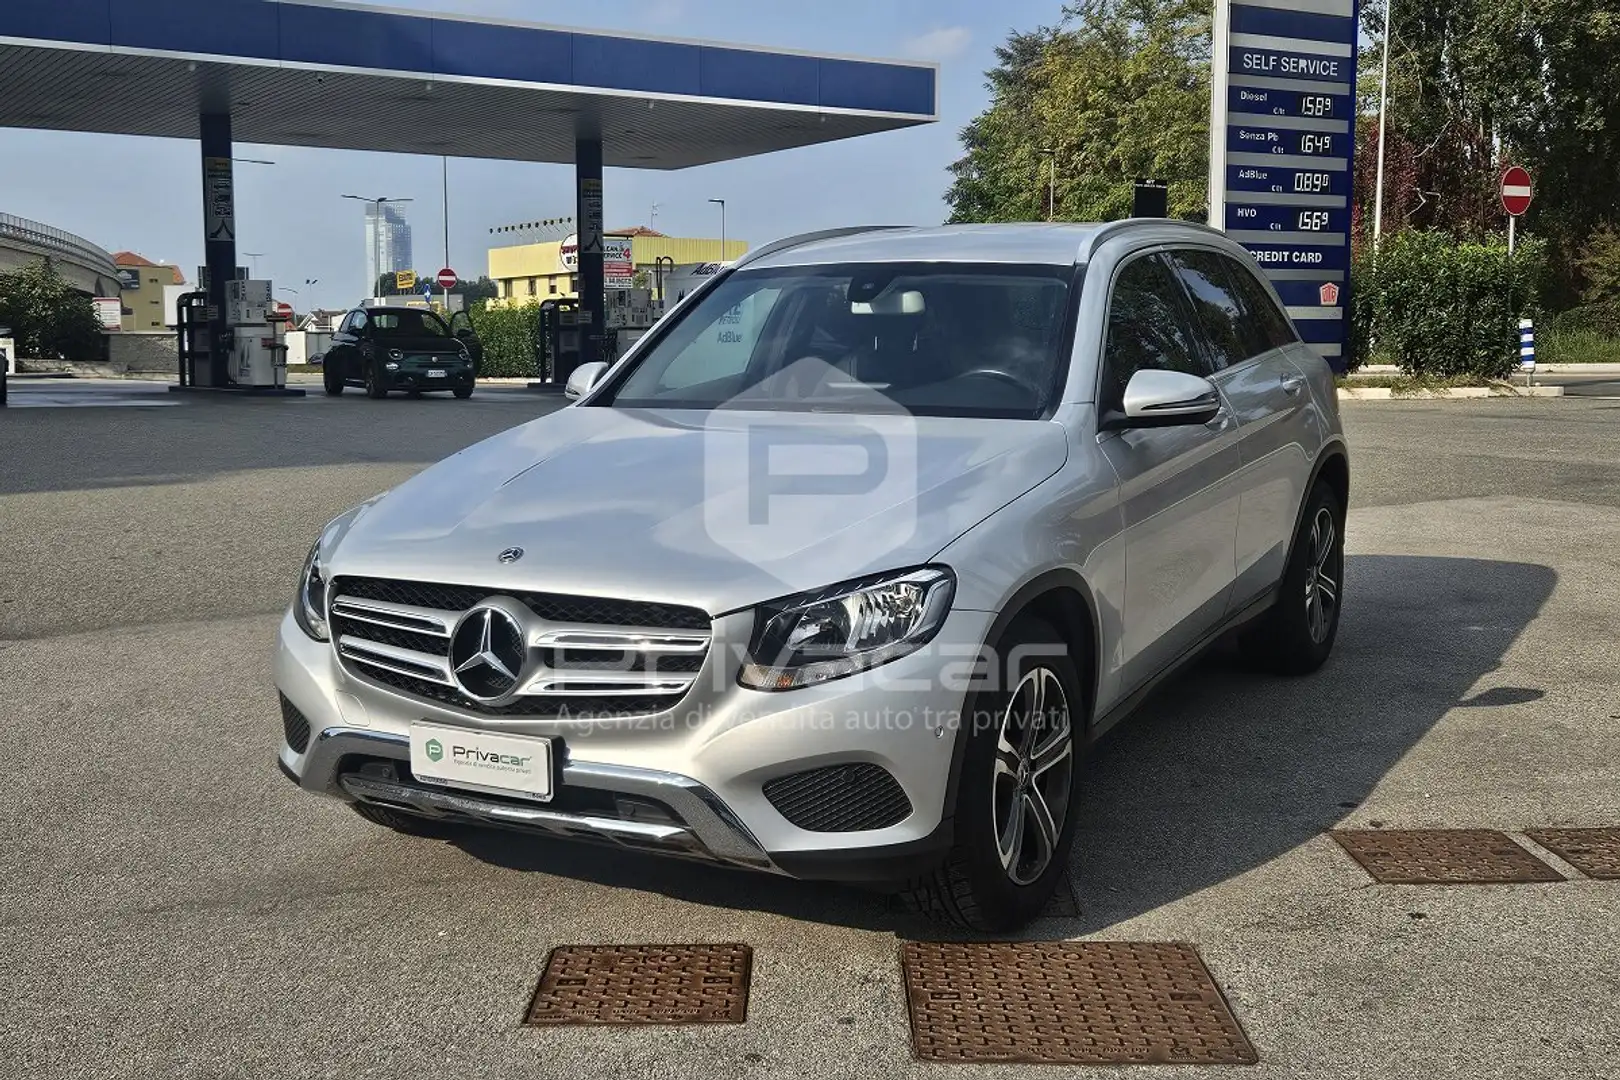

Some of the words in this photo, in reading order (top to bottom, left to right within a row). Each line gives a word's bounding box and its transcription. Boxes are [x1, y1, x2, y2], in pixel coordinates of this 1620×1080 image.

[1243, 53, 1277, 69] SELF
[1281, 57, 1338, 76] SERVICE
[1241, 91, 1267, 101] Diesel
[1240, 130, 1265, 140] Senza
[1268, 132, 1279, 141] Pb
[1238, 170, 1268, 179] AdBlue
[1237, 208, 1257, 217] HVO
[1250, 251, 1289, 262] CREDIT
[1292, 253, 1323, 263] CARD
[717, 331, 742, 342] AdBlue
[453, 746, 531, 767] Privacar
